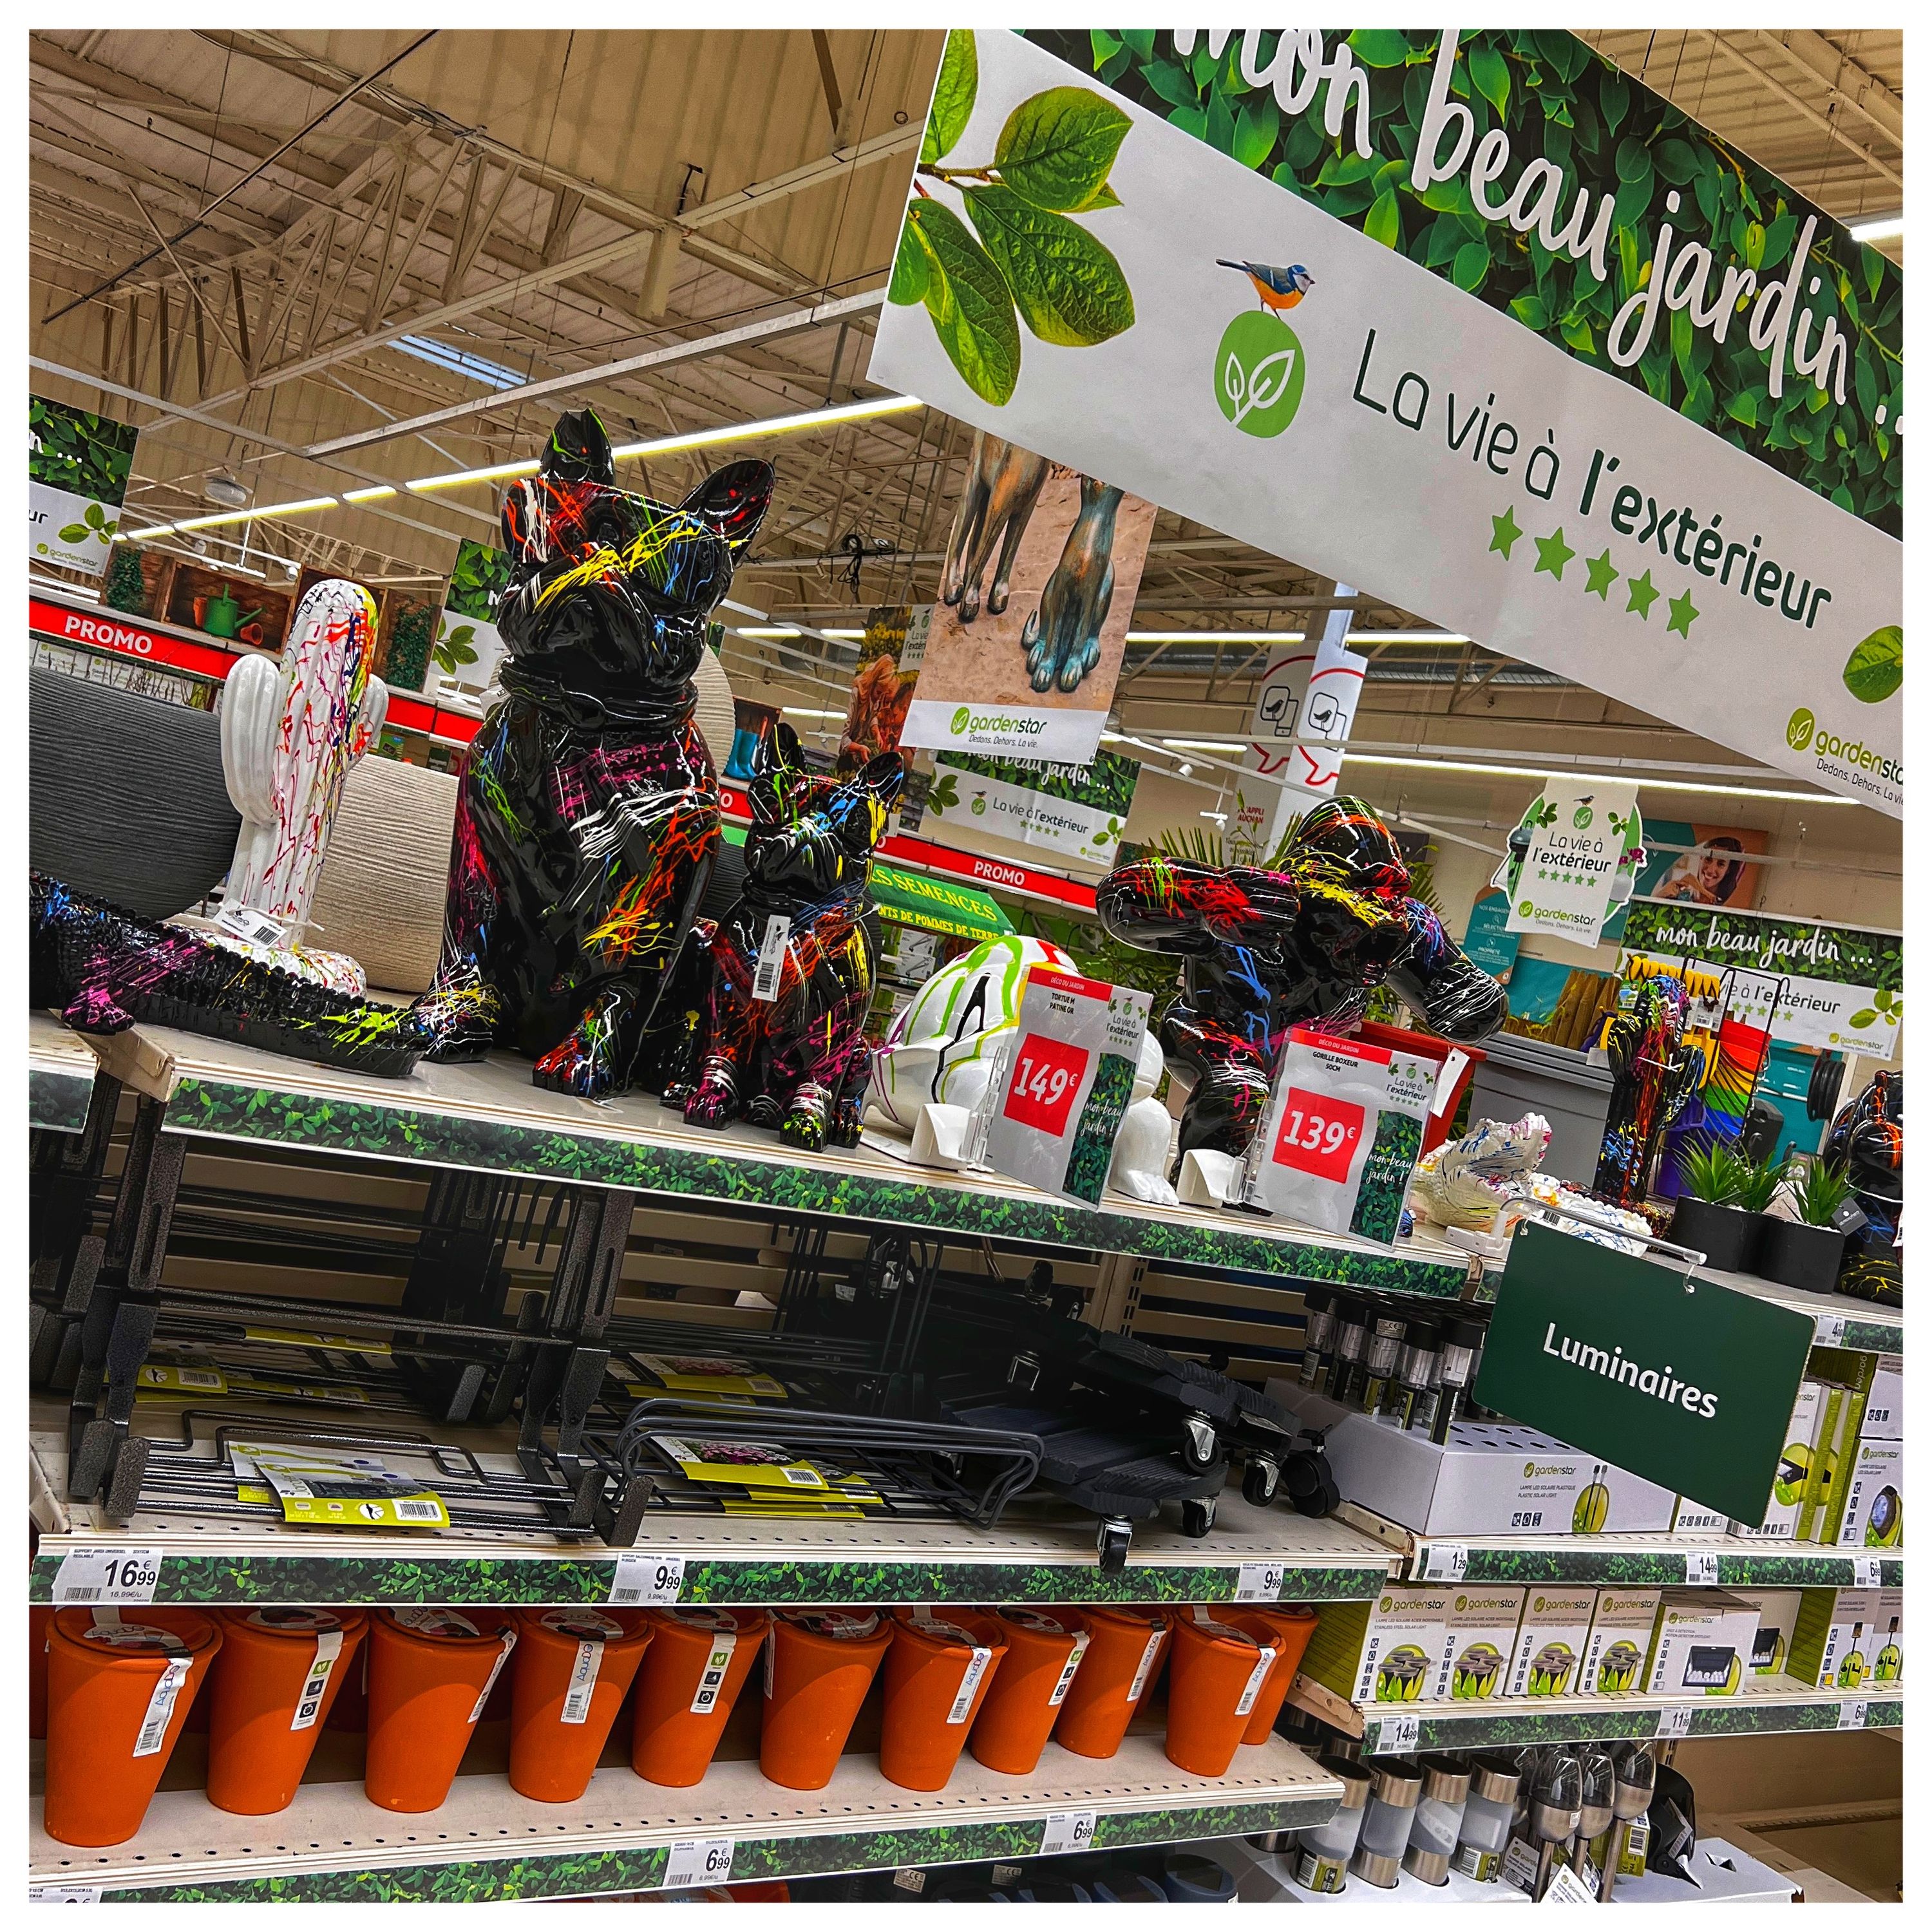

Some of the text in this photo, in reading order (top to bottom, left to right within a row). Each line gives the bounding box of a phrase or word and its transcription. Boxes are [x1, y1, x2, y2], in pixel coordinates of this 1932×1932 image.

[1413, 29, 1615, 281] beau
[1607, 191, 1847, 405] jardin
[1352, 328, 1832, 629] La vie à l'extérieur
[64, 615, 153, 654] PROMO
[968, 714, 1047, 735] gardenstar
[969, 734, 1038, 749] Dedans. Dehors. La vie.
[1814, 730, 1903, 786] gardensta
[1041, 760, 1091, 786] jardin
[1816, 757, 1850, 782] Dedans.
[1851, 773, 1882, 796] Dehors.
[1883, 786, 1893, 800] La
[992, 797, 1007, 811] La
[1009, 802, 1025, 816] vie
[1034, 809, 1089, 835] l'extérieur
[1549, 831, 1603, 853] La vie à
[1533, 848, 1611, 873] l'extérieur
[973, 860, 1025, 886] PROMO
[871, 869, 998, 922] ES SEMENCES
[900, 909, 914, 923] DE
[915, 913, 954, 933] POMMES
[956, 925, 968, 936] DE
[1534, 907, 1596, 926] gardenstar
[1656, 926, 1698, 947] mon
[1705, 916, 1759, 953] beau
[1759, 925, 1839, 969] jardin
[1051, 992, 1070, 1003] TORTUE
[1740, 983, 1749, 998] à
[1112, 1015, 1121, 1025] La
[1122, 1017, 1130, 1027] vie
[1318, 1038, 1332, 1047] DÉCO
[1341, 1043, 1359, 1054] JARDIN
[1840, 1036, 1884, 1050] gardenstar
[1312, 1051, 1359, 1068] GORILLE BOXEUR
[1325, 1063, 1341, 1072] 50CM
[1394, 1077, 1423, 1092] La vie à
[1084, 1098, 1122, 1117] mon beau
[1080, 1116, 1106, 1137] jardin
[1368, 1151, 1412, 1169] mon beau
[1365, 1168, 1396, 1184] jardin
[1542, 1321, 1719, 1419] Luminaires
[1855, 1355, 1868, 1390] garden
[1796, 1393, 1815, 1401] enstar
[1869, 1448, 1899, 1460] gardenstar
[1534, 1464, 1577, 1477] gardenstar
[1393, 1598, 1446, 1612] gardenstar
[1468, 1598, 1518, 1611] gardenstar
[1546, 1599, 1591, 1611] gardenstar
[1613, 1599, 1656, 1611] gardenstar
[1678, 1615, 1714, 1624] gardenstar
